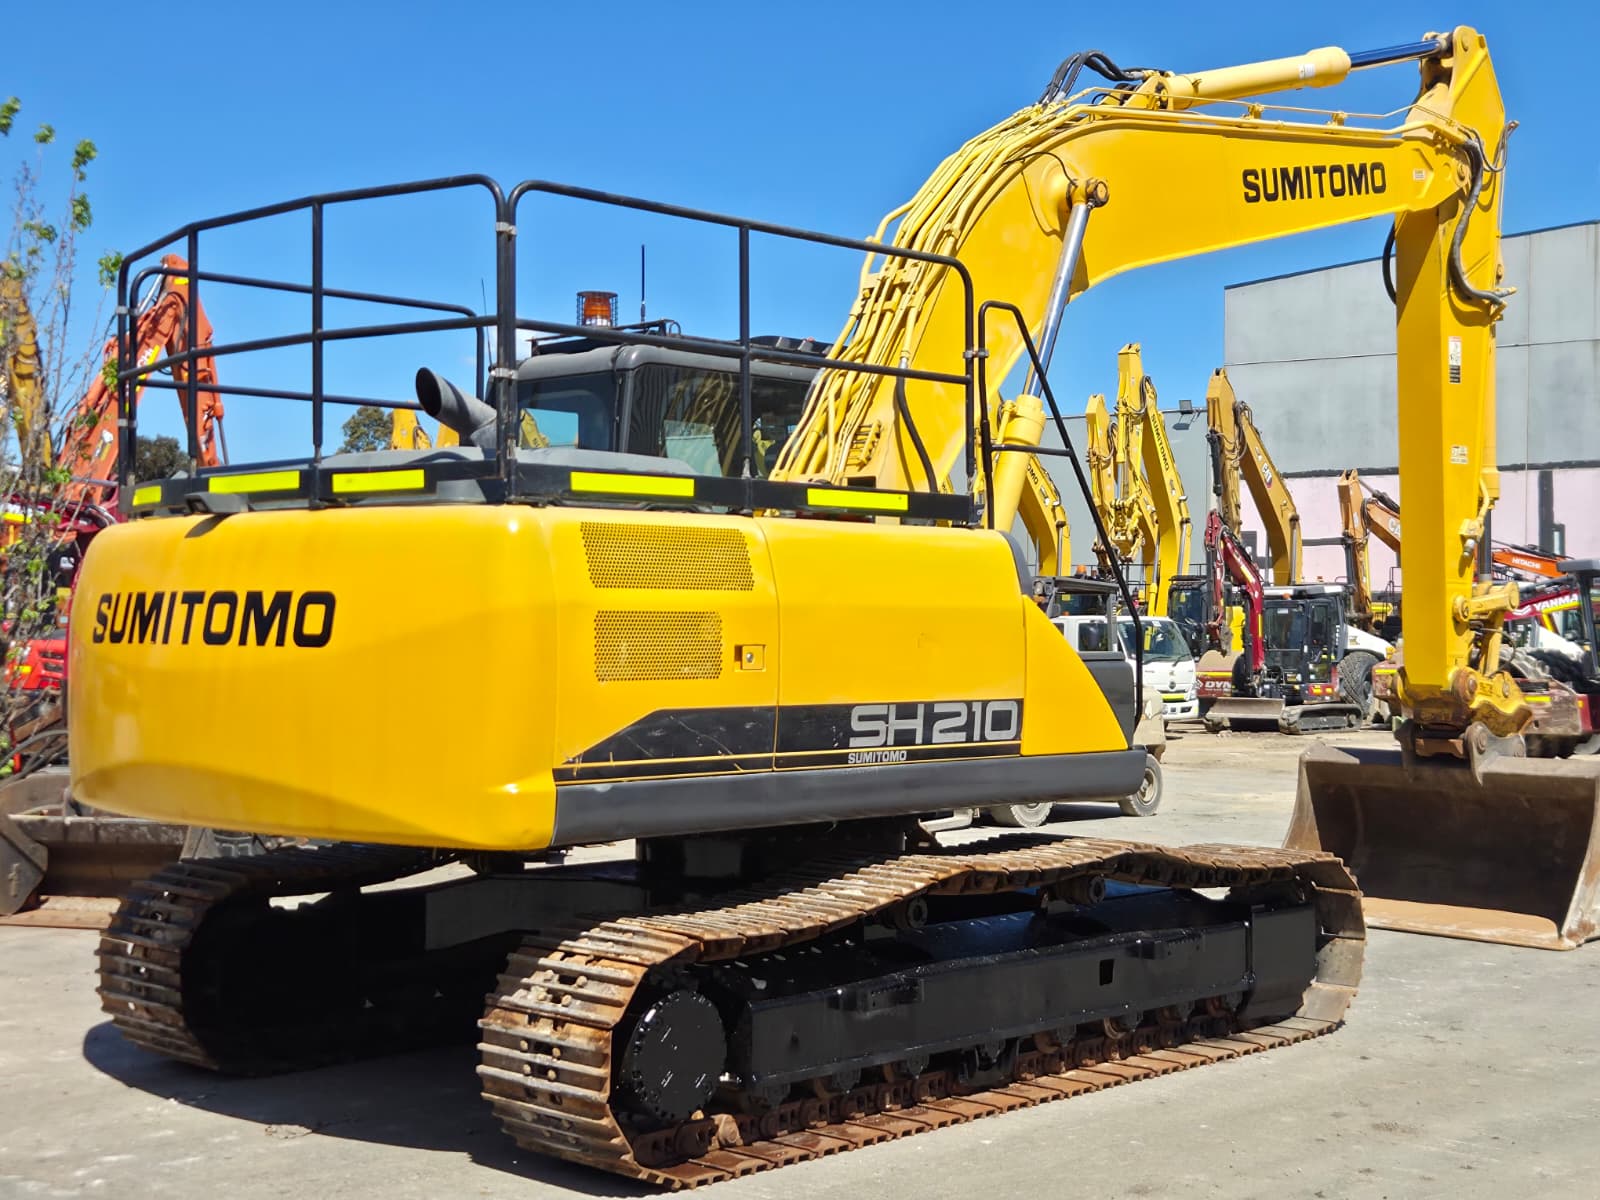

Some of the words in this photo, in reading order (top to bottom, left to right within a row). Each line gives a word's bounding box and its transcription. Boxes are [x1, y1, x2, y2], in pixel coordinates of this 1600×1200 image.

[1242, 161, 1387, 204] SUMITOMO
[1151, 413, 1170, 471] SUMITOMO
[1511, 557, 1541, 569] HITACHI
[92, 590, 337, 648] SUMITOMO
[848, 750, 907, 765] SUMITOMO
